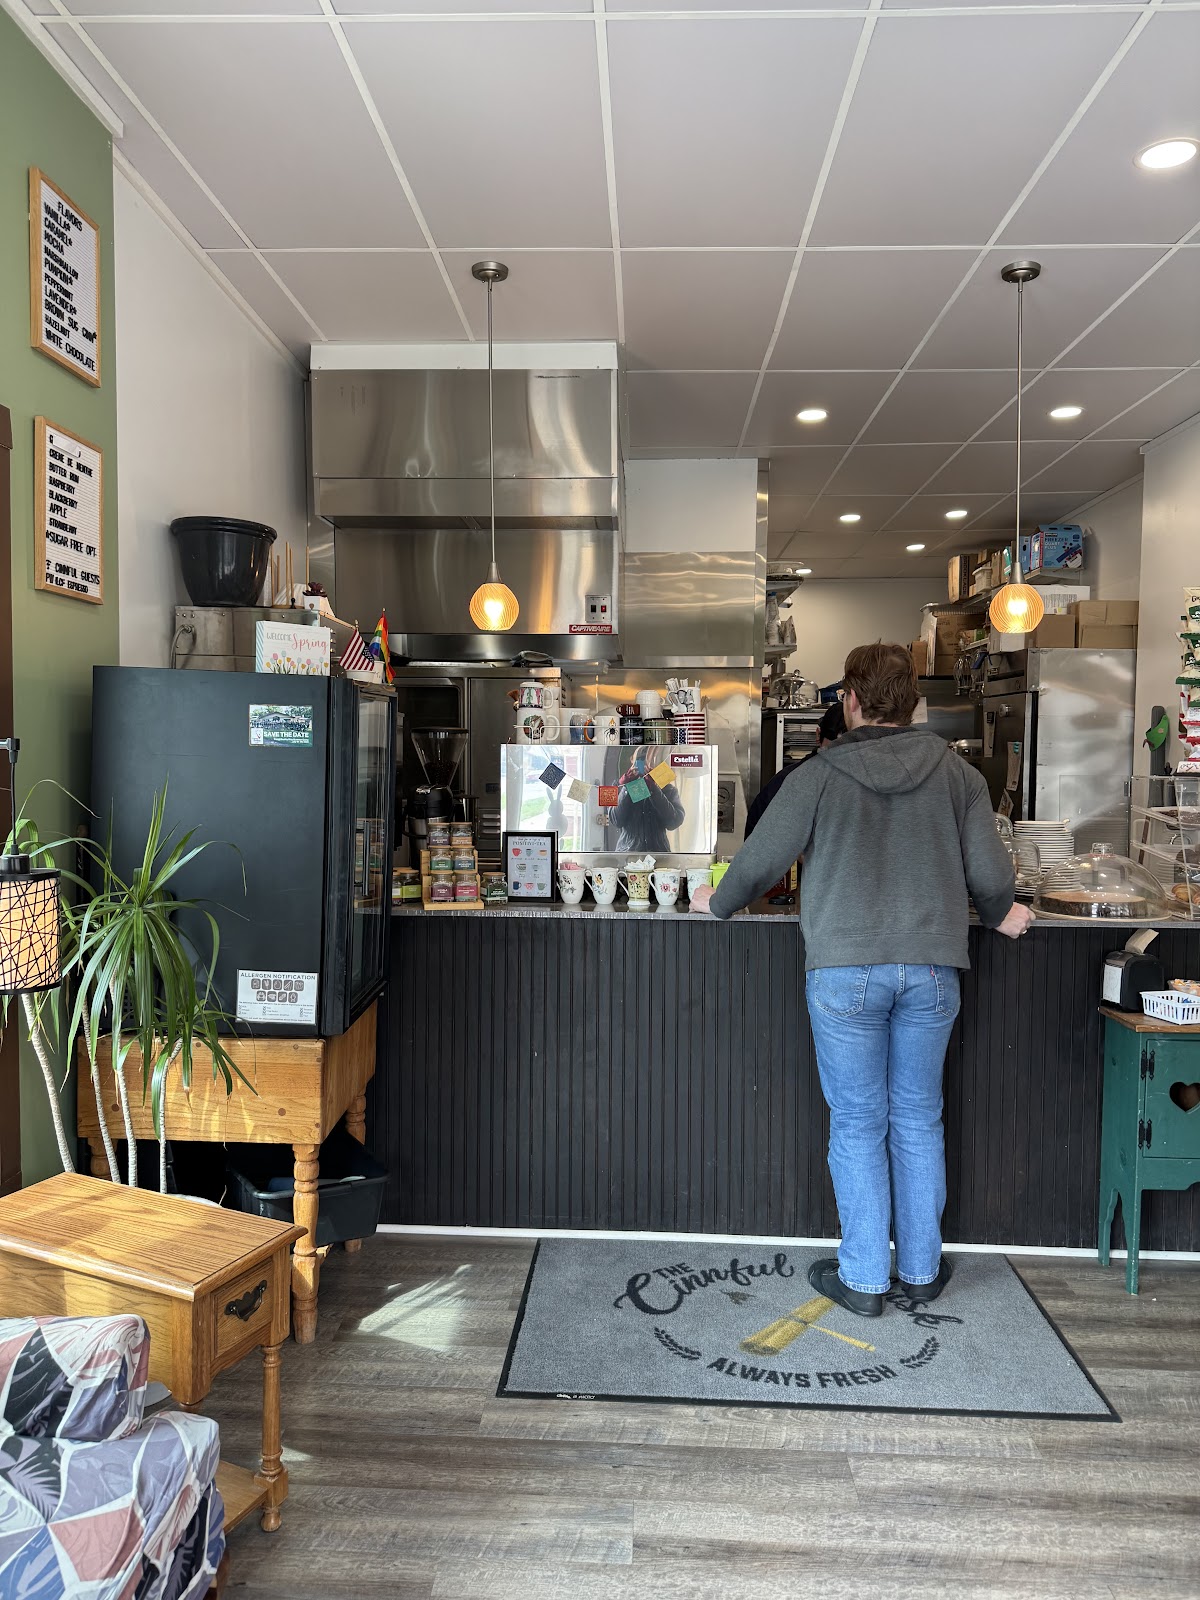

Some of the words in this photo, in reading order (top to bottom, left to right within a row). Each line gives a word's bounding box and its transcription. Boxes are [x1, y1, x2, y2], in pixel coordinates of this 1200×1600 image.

[57, 201, 83, 232] FLAVORS
[44, 230, 65, 255] MOCHA
[44, 273, 74, 302] PEPPERMINT
[44, 298, 65, 322] BROWN
[44, 327, 63, 350] WHITE
[65, 342, 96, 372] CHOCOLATE
[49, 475, 76, 495] RASPBERRY
[49, 489, 79, 510] BLACKBERRY
[49, 502, 68, 519] APPLE
[70, 538, 84, 553] FREE
[80, 570, 101, 585] GUESTS
[266, 632, 292, 641] WELCOME
[292, 632, 327, 655] Spring
[652, 1262, 695, 1280] THE
[612, 1252, 796, 1316] Cinnful
[706, 1357, 811, 1389] ALWAYS
[817, 1363, 897, 1392] FRESH
